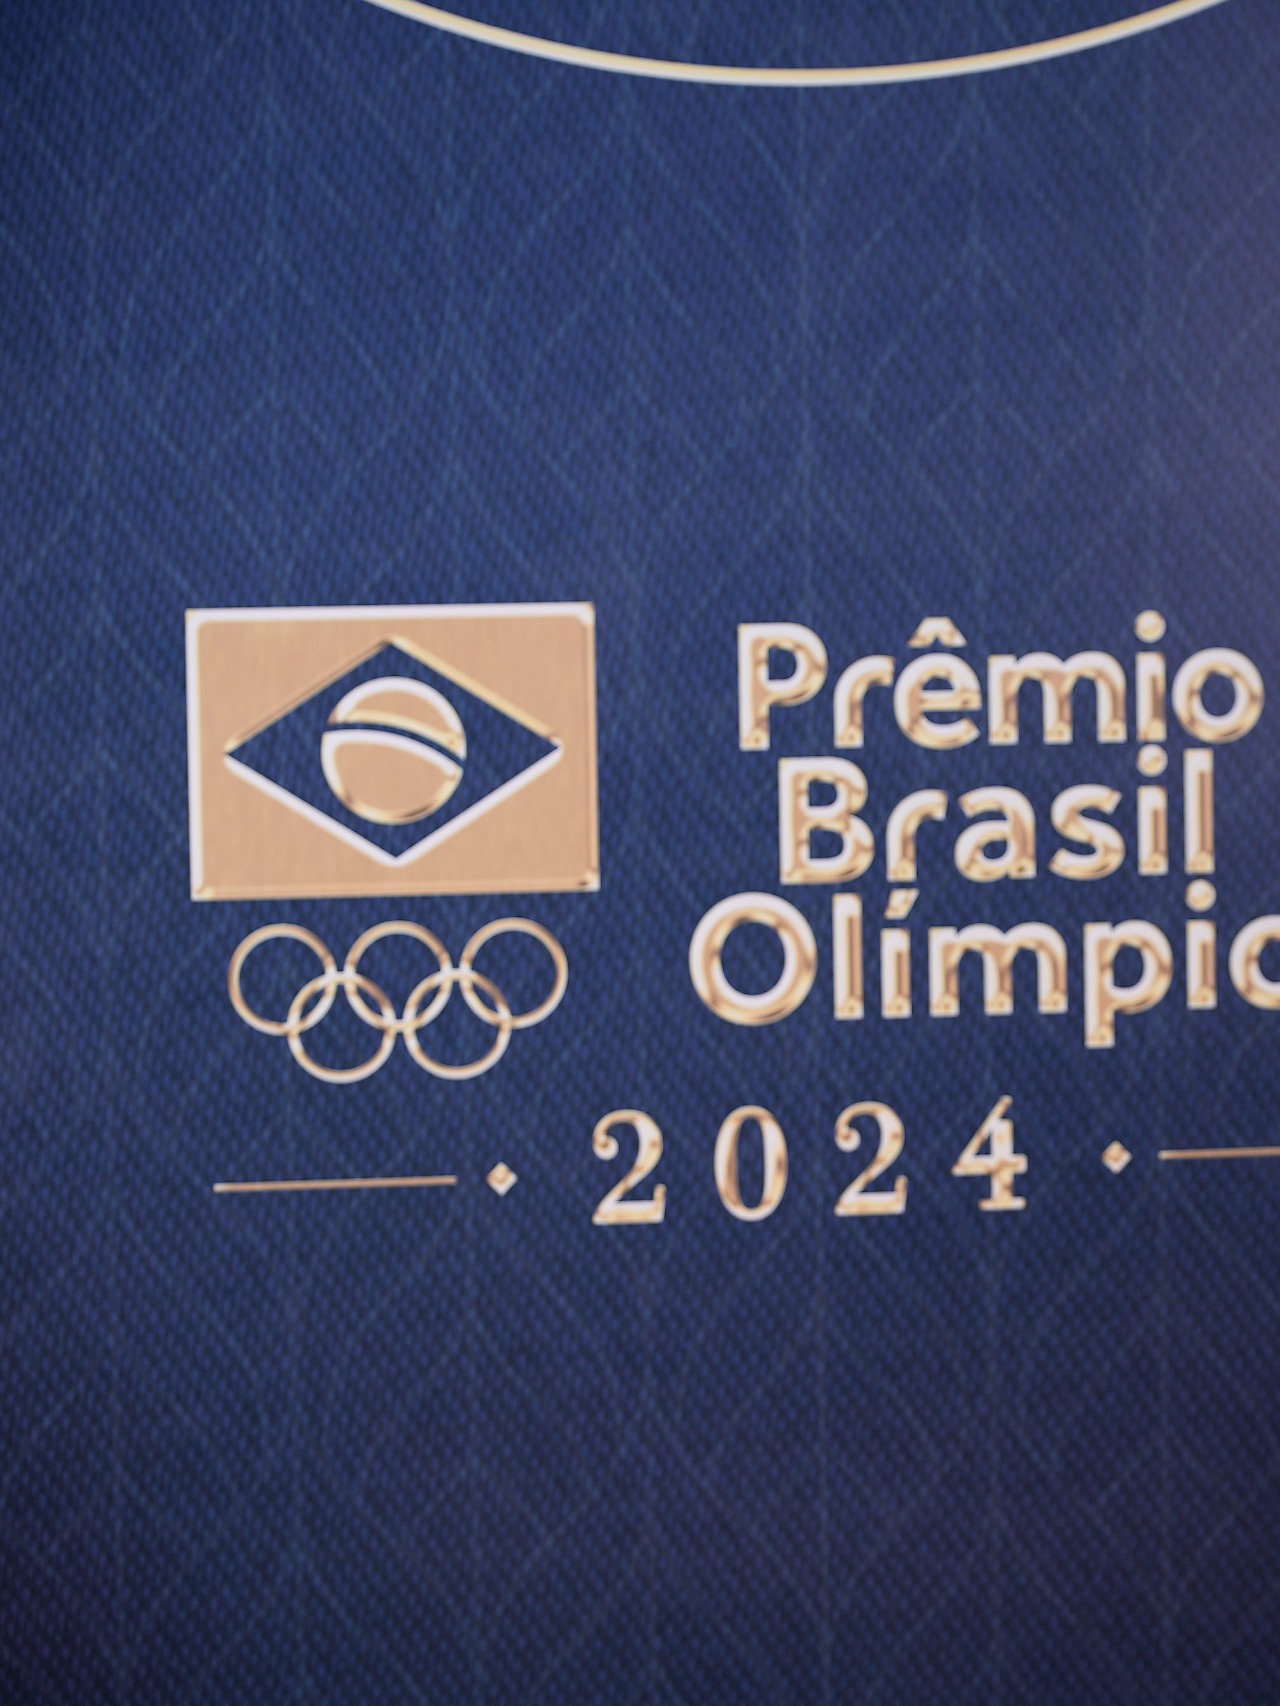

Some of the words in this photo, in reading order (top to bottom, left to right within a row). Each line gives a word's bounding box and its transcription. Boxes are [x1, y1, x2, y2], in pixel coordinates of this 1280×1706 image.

[737, 609, 1265, 752] Prêmio
[778, 744, 1217, 885] Brasil
[592, 1094, 1028, 1227] 2024
